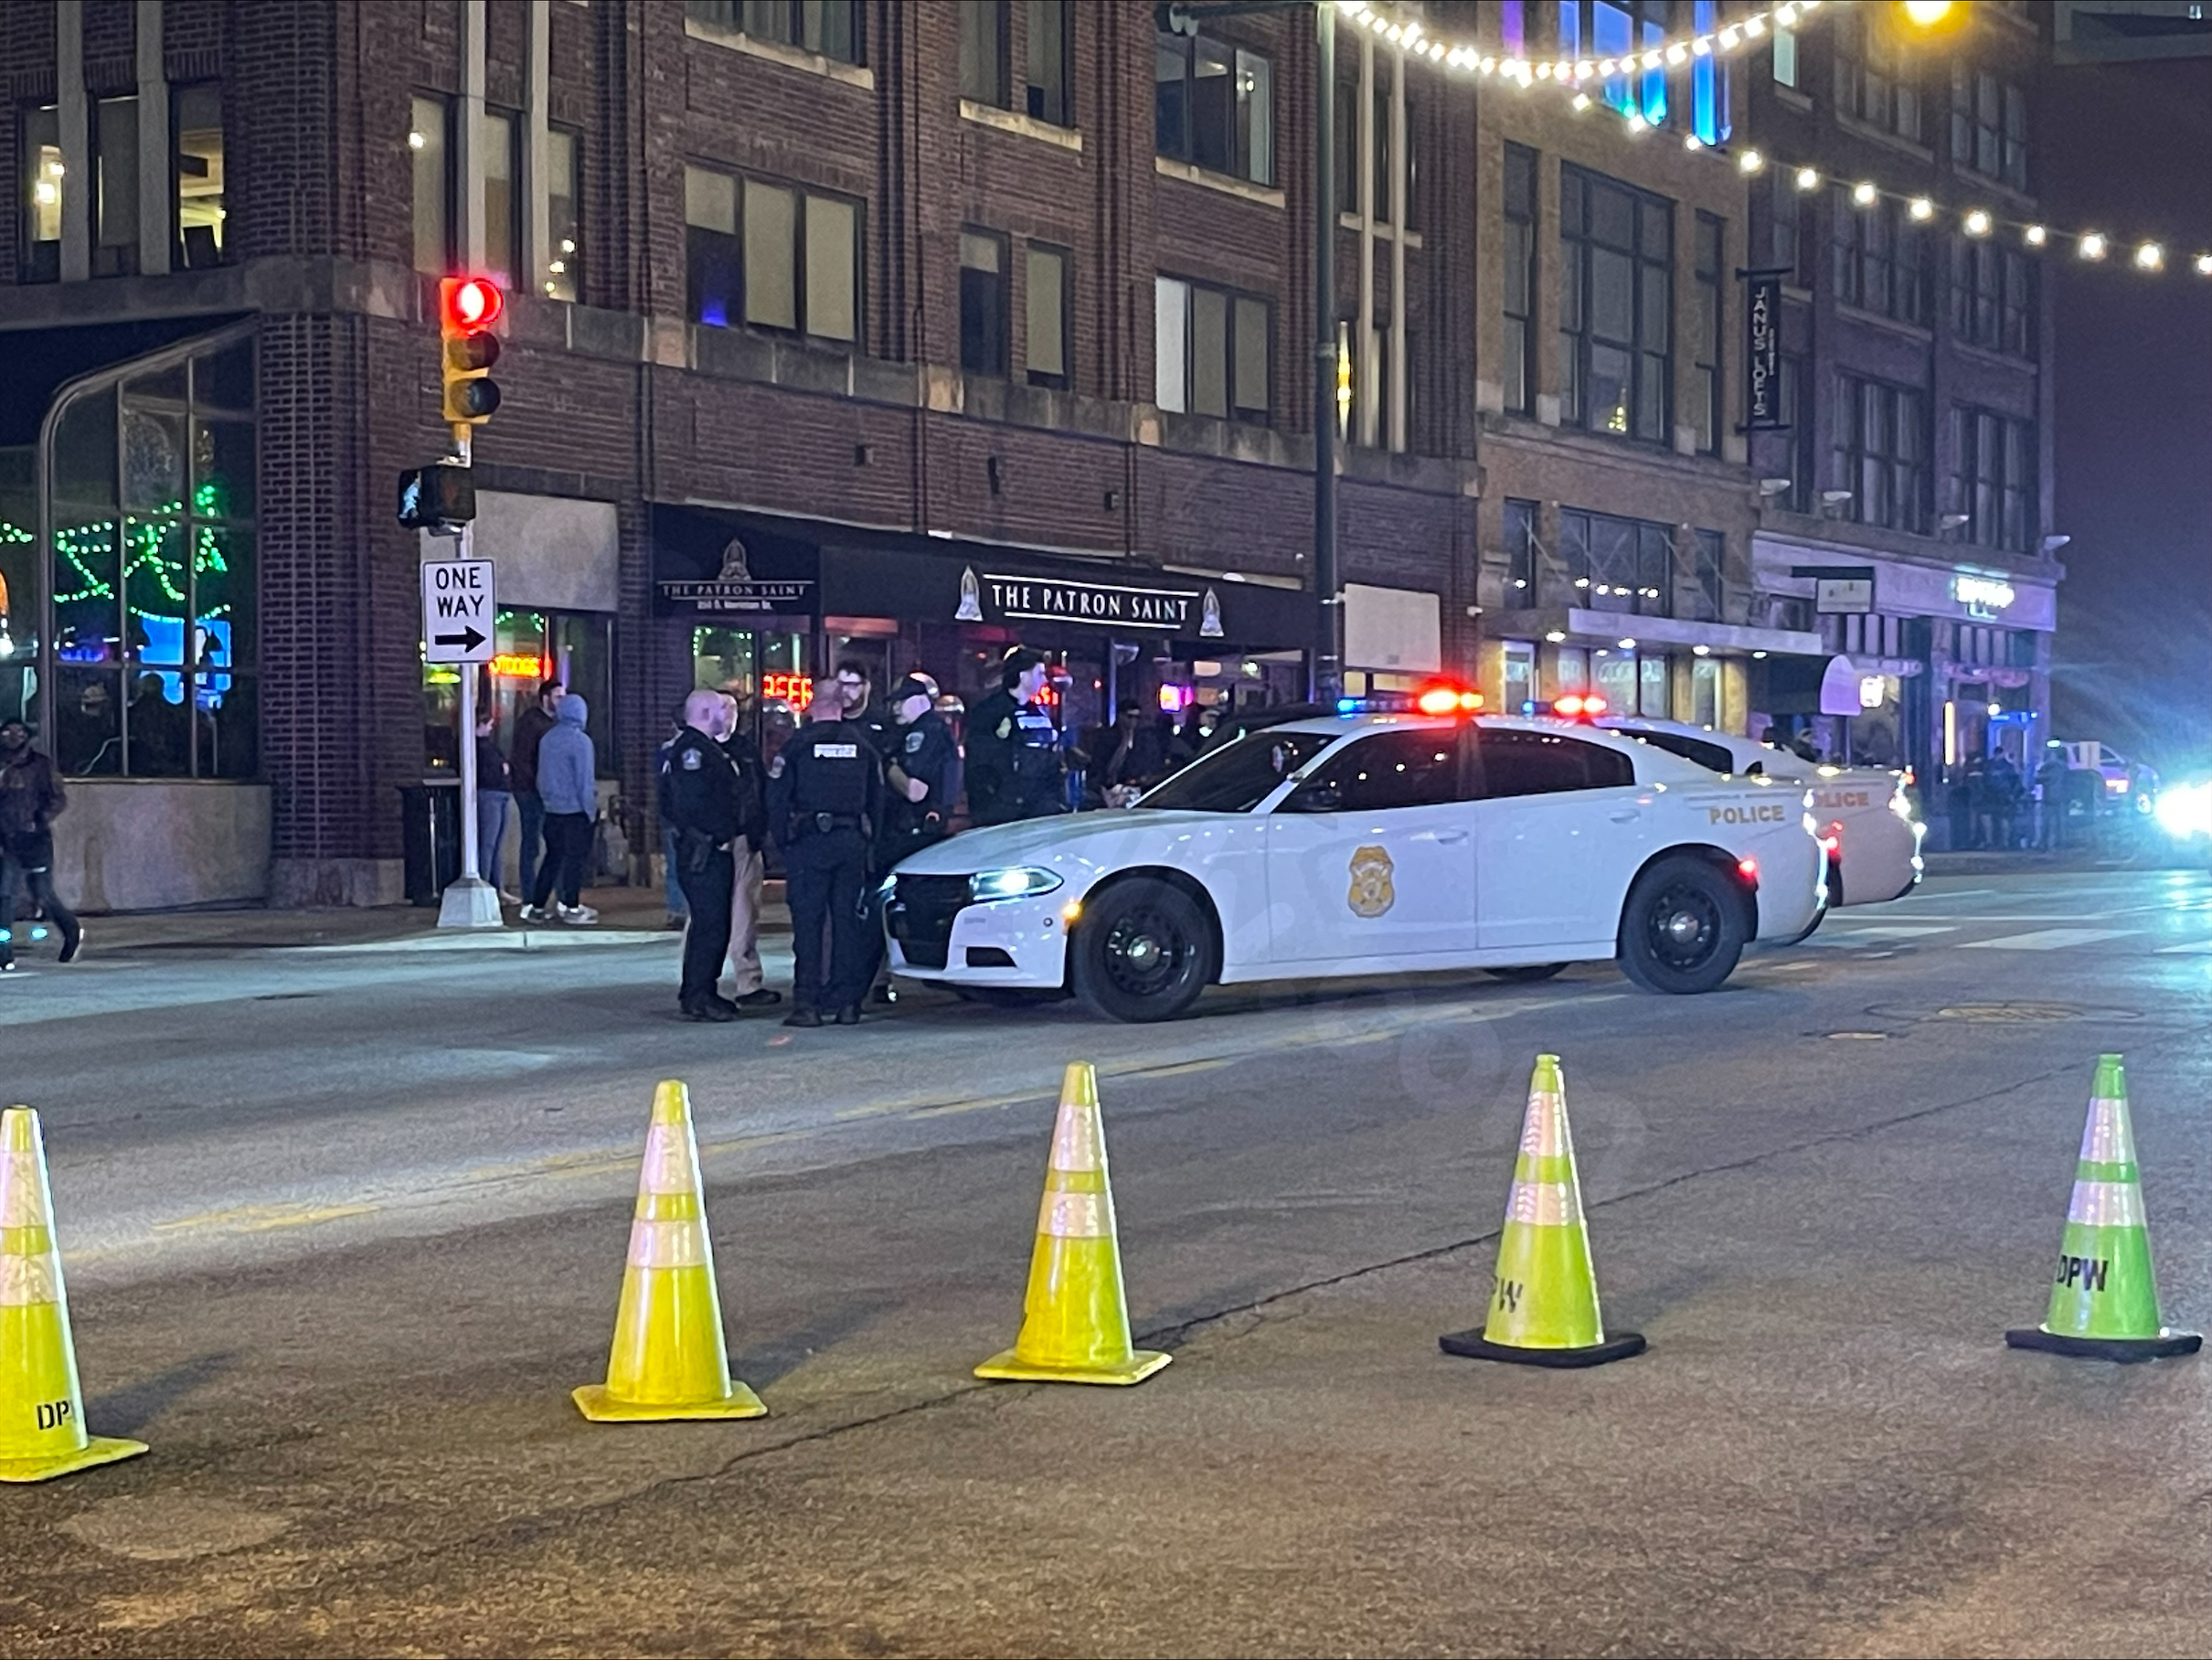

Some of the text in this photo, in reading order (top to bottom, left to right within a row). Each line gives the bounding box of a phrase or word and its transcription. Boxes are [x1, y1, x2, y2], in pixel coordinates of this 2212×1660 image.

[1753, 286, 1767, 416] JANUS LOFTS
[436, 567, 482, 591] ONE
[663, 585, 806, 596] THE PATRON SAINT
[437, 594, 484, 618] WAY
[992, 584, 1187, 621] THE PATRON SAINT
[1710, 804, 1785, 825] POLICE
[2057, 1254, 2109, 1292] DPW
[37, 1399, 77, 1430] DP
